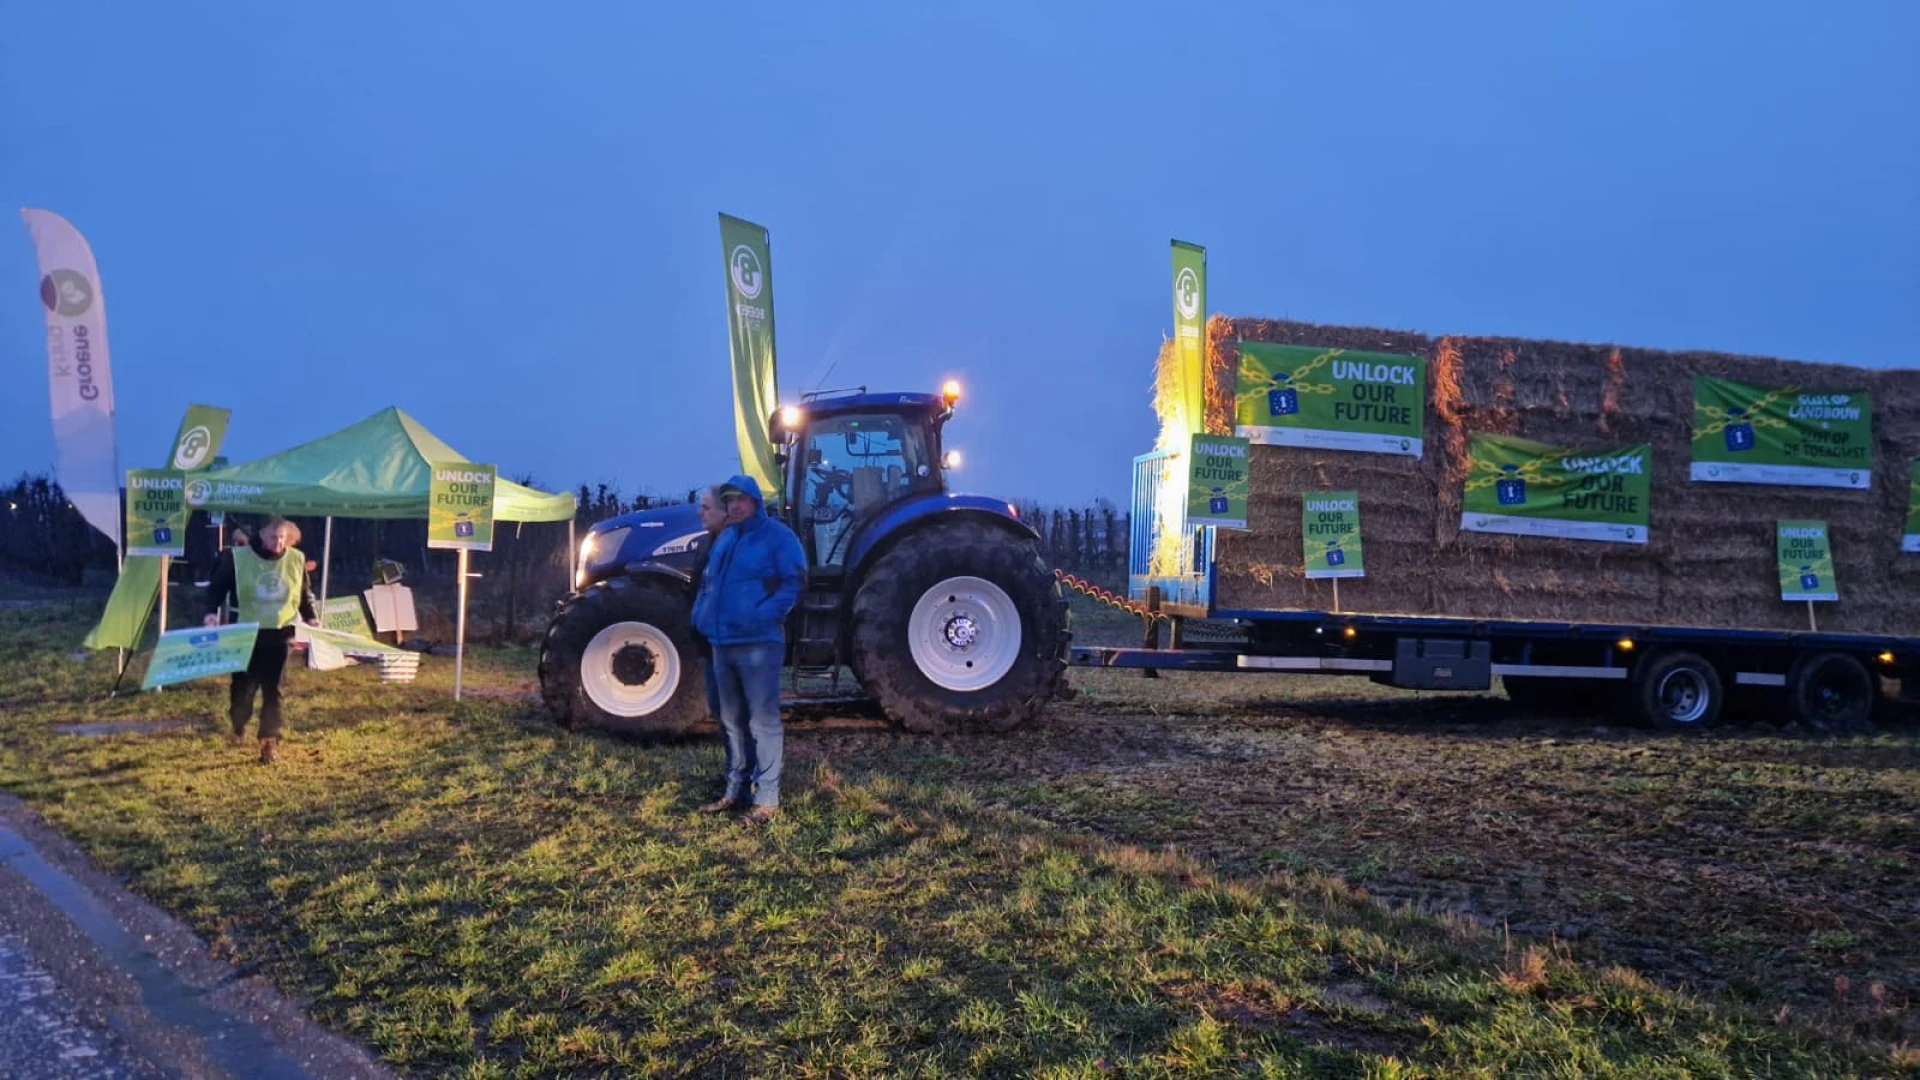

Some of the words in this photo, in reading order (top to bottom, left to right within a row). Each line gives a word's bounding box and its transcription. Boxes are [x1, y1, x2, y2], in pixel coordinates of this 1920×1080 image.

[1332, 360, 1415, 384] UNLOCK
[1353, 383, 1395, 403] OUR
[1334, 402, 1411, 424] FUTURE
[1788, 405, 1860, 420] LANDBOUW
[1194, 442, 1246, 457] UNLOCK
[1205, 456, 1233, 469] OUR
[1561, 455, 1644, 474] UNLOCK
[436, 470, 492, 484] UNLOCK
[1194, 467, 1243, 481] FUTURE
[131, 477, 183, 489] UNLOCK
[449, 483, 478, 494] OUR
[1581, 474, 1624, 492] OUR
[146, 489, 174, 500] OUR
[437, 494, 489, 506] FUTURE
[1307, 500, 1354, 512] UNLOCK
[1562, 493, 1639, 513] FUTURE
[1318, 511, 1344, 523] OUR
[1308, 522, 1355, 535] FUTURE
[1780, 526, 1825, 538] UNLOCK
[1791, 538, 1815, 548] OUR
[1783, 548, 1826, 560] FUTURE
